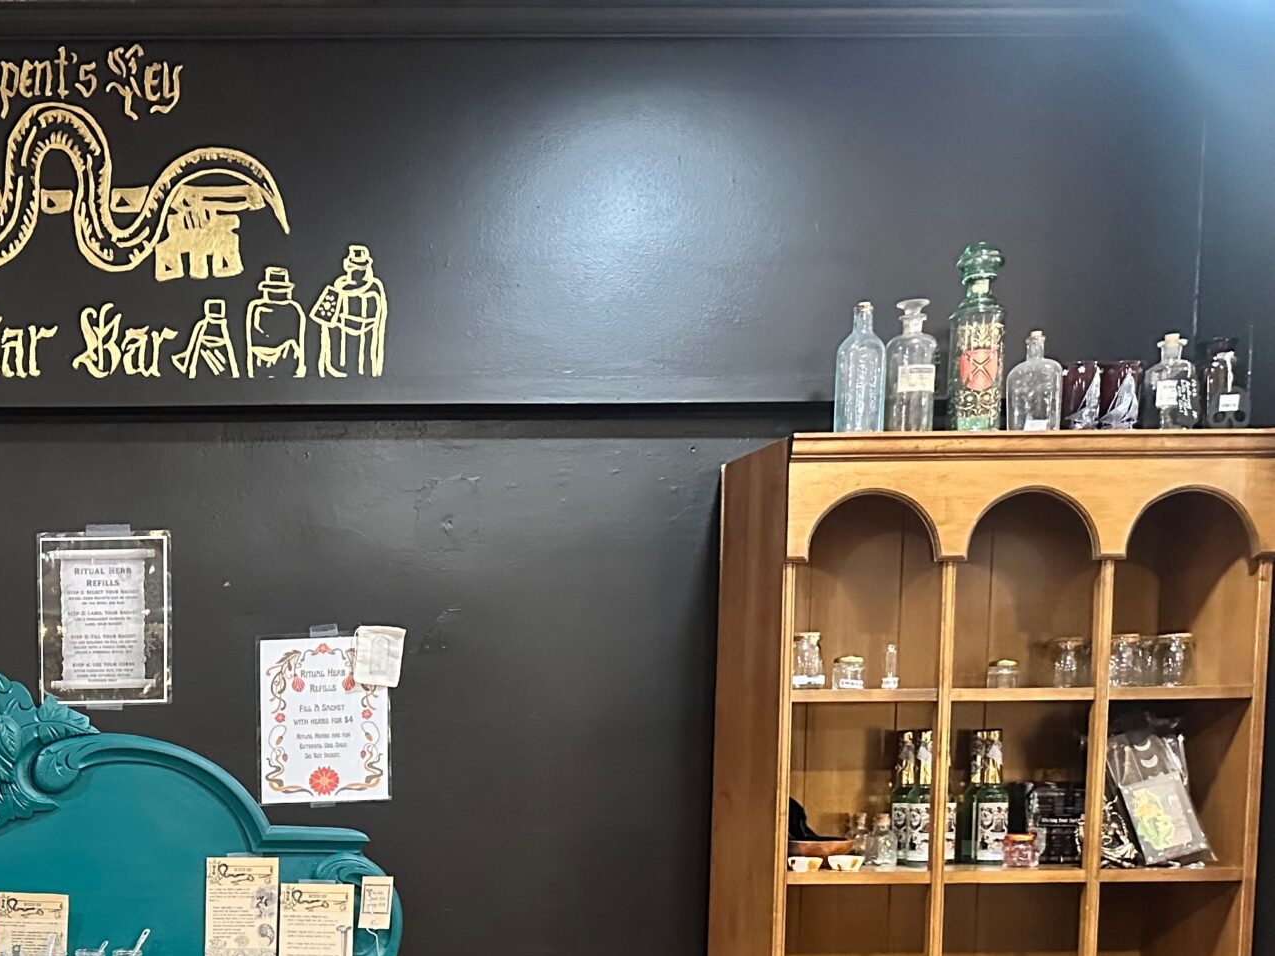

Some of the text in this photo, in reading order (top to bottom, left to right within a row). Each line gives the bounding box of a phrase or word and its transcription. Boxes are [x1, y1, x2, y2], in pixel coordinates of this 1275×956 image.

[105, 43, 184, 121] Key
[72, 302, 179, 379] Bar
[74, 566, 132, 576] RITUAL HERB
[86, 579, 120, 587] REFILLS
[300, 668, 346, 678] RITUAL HERB
[309, 683, 337, 693] REFILLS
[299, 703, 345, 713] FILL A SACHET
[293, 715, 353, 726] WITH HERBS FOR $4
